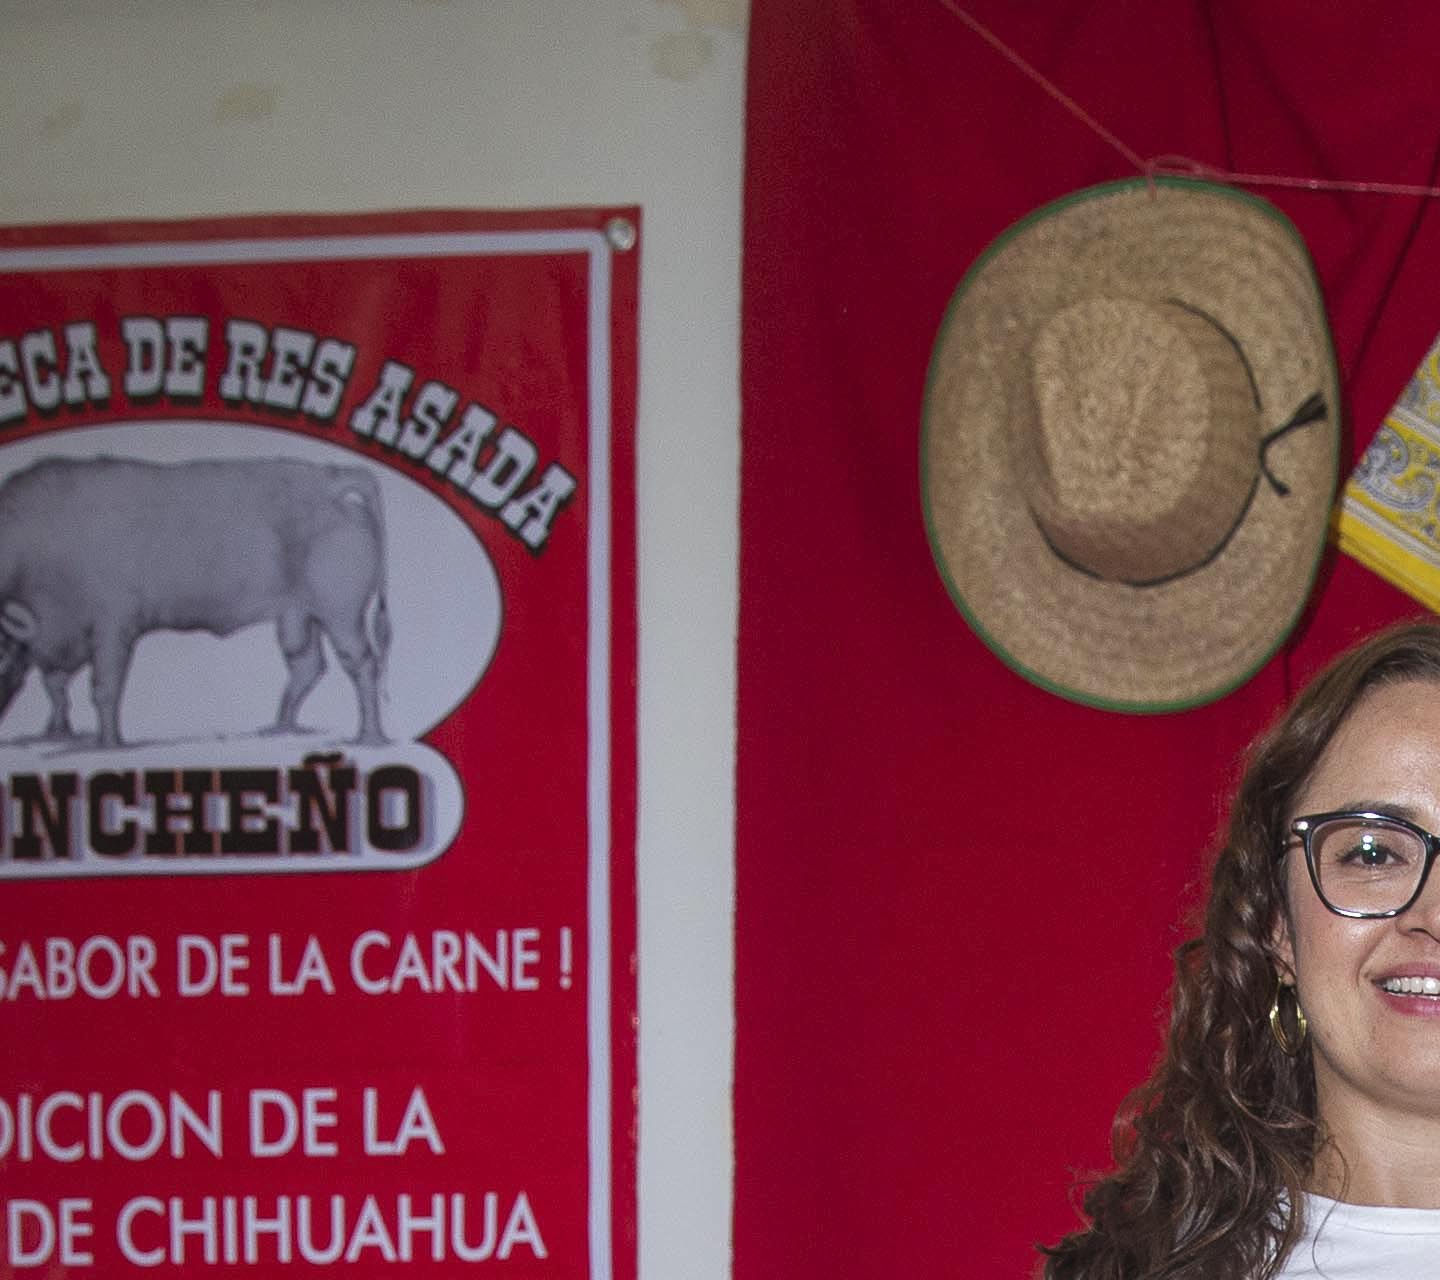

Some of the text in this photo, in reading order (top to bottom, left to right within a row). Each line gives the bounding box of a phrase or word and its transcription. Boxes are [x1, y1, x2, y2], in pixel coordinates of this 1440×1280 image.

[121, 316, 209, 398] DE
[217, 319, 356, 422] RES
[354, 362, 577, 550] ASADA
[178, 934, 249, 996] DE
[269, 934, 335, 995] LA
[351, 928, 540, 994] CARNE
[250, 1088, 338, 1157] DE
[364, 1088, 444, 1155] LA
[8, 1198, 93, 1267] DE
[118, 1192, 547, 1266] CHIHUAHUA
